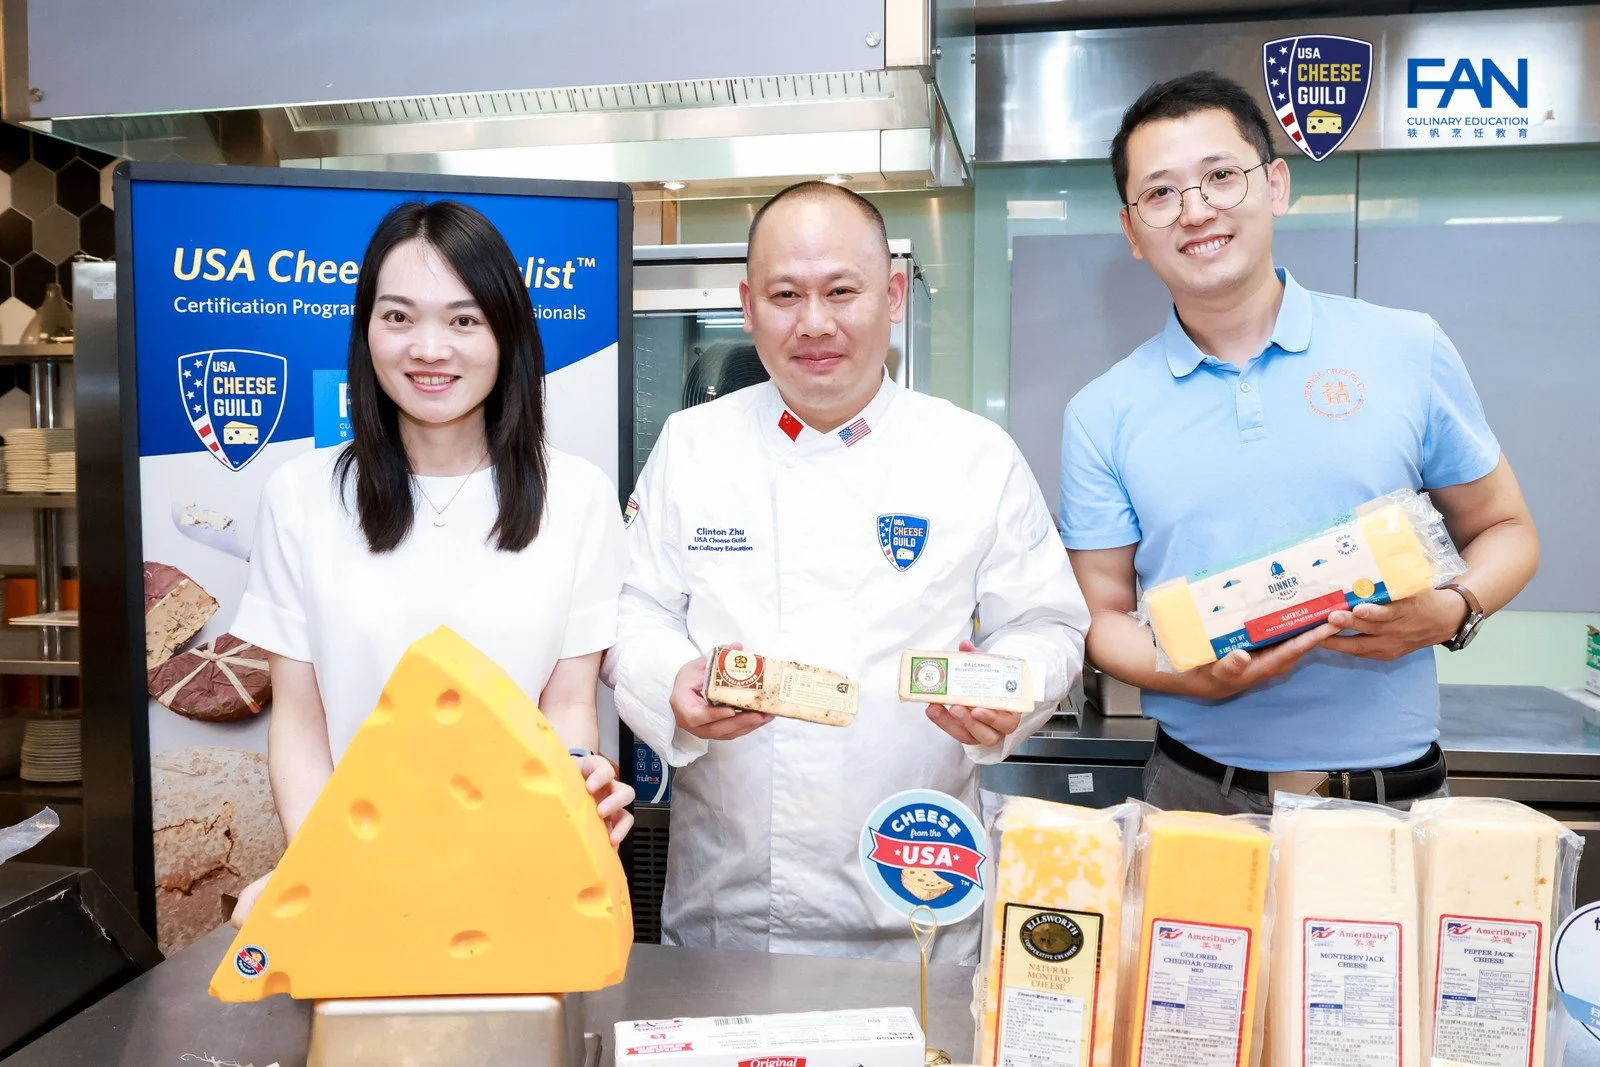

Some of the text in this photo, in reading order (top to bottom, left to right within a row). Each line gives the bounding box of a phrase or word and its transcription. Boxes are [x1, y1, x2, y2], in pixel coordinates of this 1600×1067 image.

[173, 248, 256, 282] USA
[268, 250, 358, 284] Chee
[174, 296, 288, 316] Certification
[532, 304, 586, 320] sionals
[212, 361, 236, 372] USA
[212, 377, 277, 395] CHEESE
[214, 399, 262, 417] GUILD
[894, 518, 905, 526] USA
[696, 528, 744, 536] Clinton Zhu
[894, 526, 924, 537] CHEESE
[893, 536, 916, 548] GUILD
[1268, 576, 1299, 594] DINNER
[1281, 608, 1310, 622] AMERICAN
[892, 808, 961, 838] CHEESE
[910, 828, 942, 838] from the
[902, 845, 953, 866] USA
[1026, 914, 1079, 936] ELLSWORTH
[1339, 930, 1389, 941] AmeriDairy
[1476, 927, 1527, 938] AmeriDairy
[1187, 932, 1237, 945] AmeriDairy
[1054, 944, 1078, 960] CREAMERY
[1180, 951, 1218, 961] COLORED
[1320, 953, 1363, 961] MONTEREY
[1494, 950, 1515, 958] JACK
[1028, 963, 1070, 974] NATURAL
[1163, 958, 1233, 970] CHEDDAR CHEESE
[1031, 980, 1065, 990] CHEESE
[750, 1058, 798, 1067] Original
